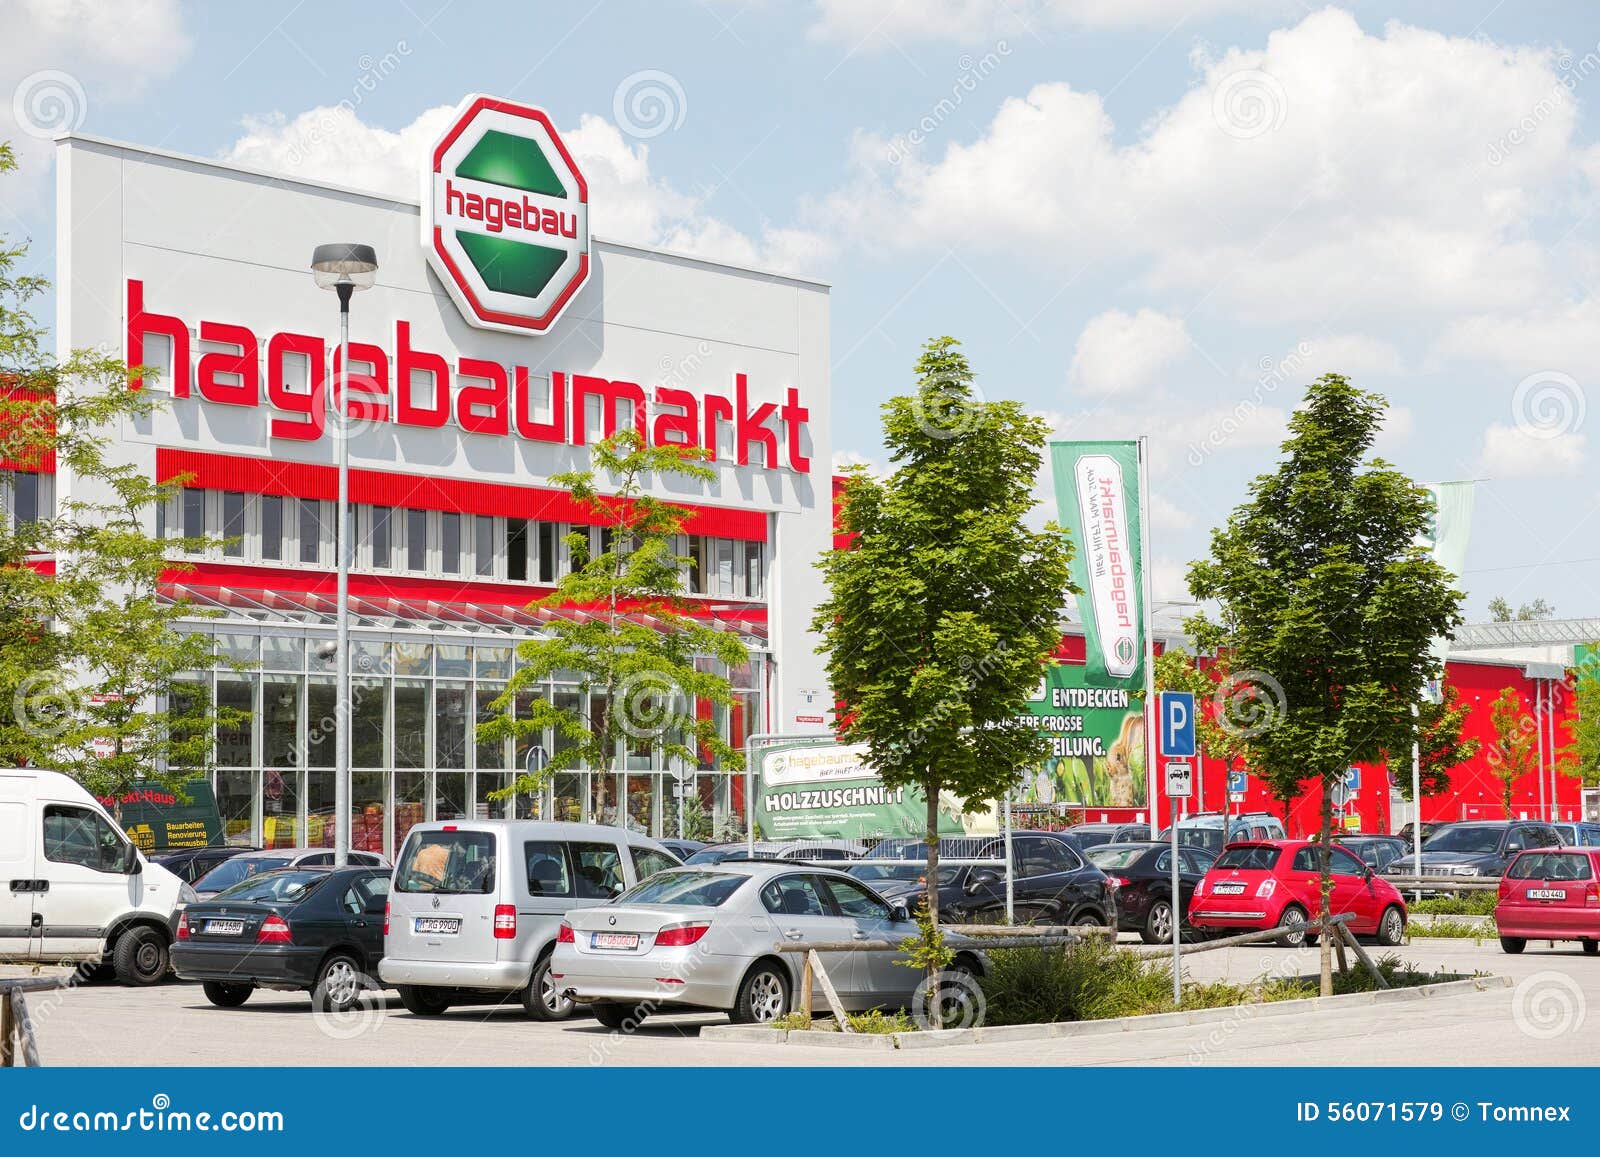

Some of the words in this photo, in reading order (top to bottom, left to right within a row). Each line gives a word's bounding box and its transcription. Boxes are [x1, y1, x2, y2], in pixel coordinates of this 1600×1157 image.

[446, 179, 577, 240] hagebau
[127, 279, 810, 474] hagebaumarkt
[1052, 688, 1129, 708] ENTDECKEN
[1042, 716, 1083, 731] GROSSE
[1170, 701, 1187, 748] P
[764, 785, 905, 813] HOLZZUSCHNITT
[166, 821, 205, 831] Bauarbeiten
[167, 831, 207, 840] Renovierung
